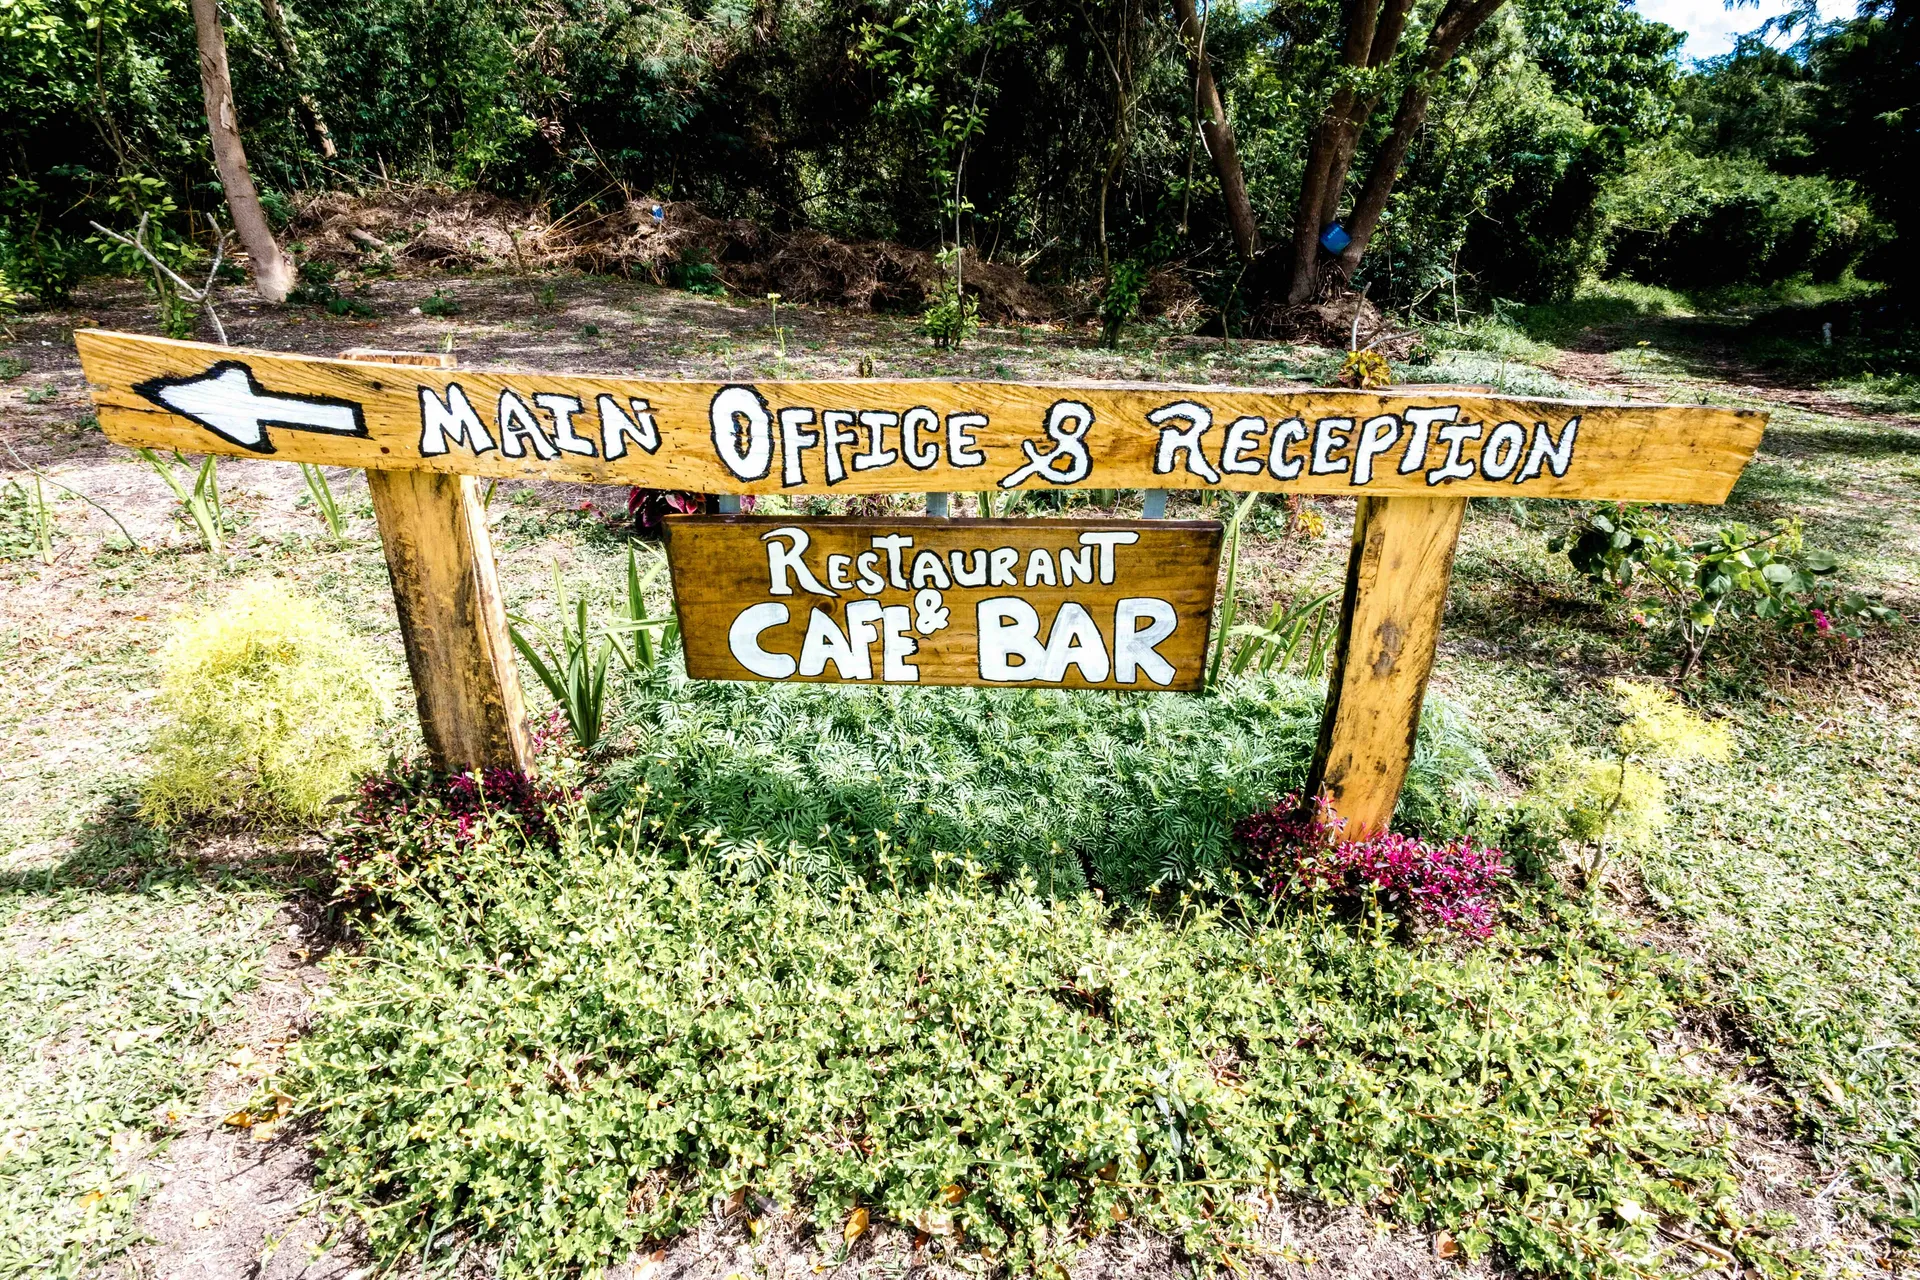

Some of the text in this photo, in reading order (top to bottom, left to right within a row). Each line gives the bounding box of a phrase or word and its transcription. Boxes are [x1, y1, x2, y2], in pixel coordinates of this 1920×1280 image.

[418, 382, 1582, 489] MAIN OFFICE & RECEPTION
[760, 526, 1140, 597] RESTAURANT
[728, 588, 1179, 686] CAFE & BAR
